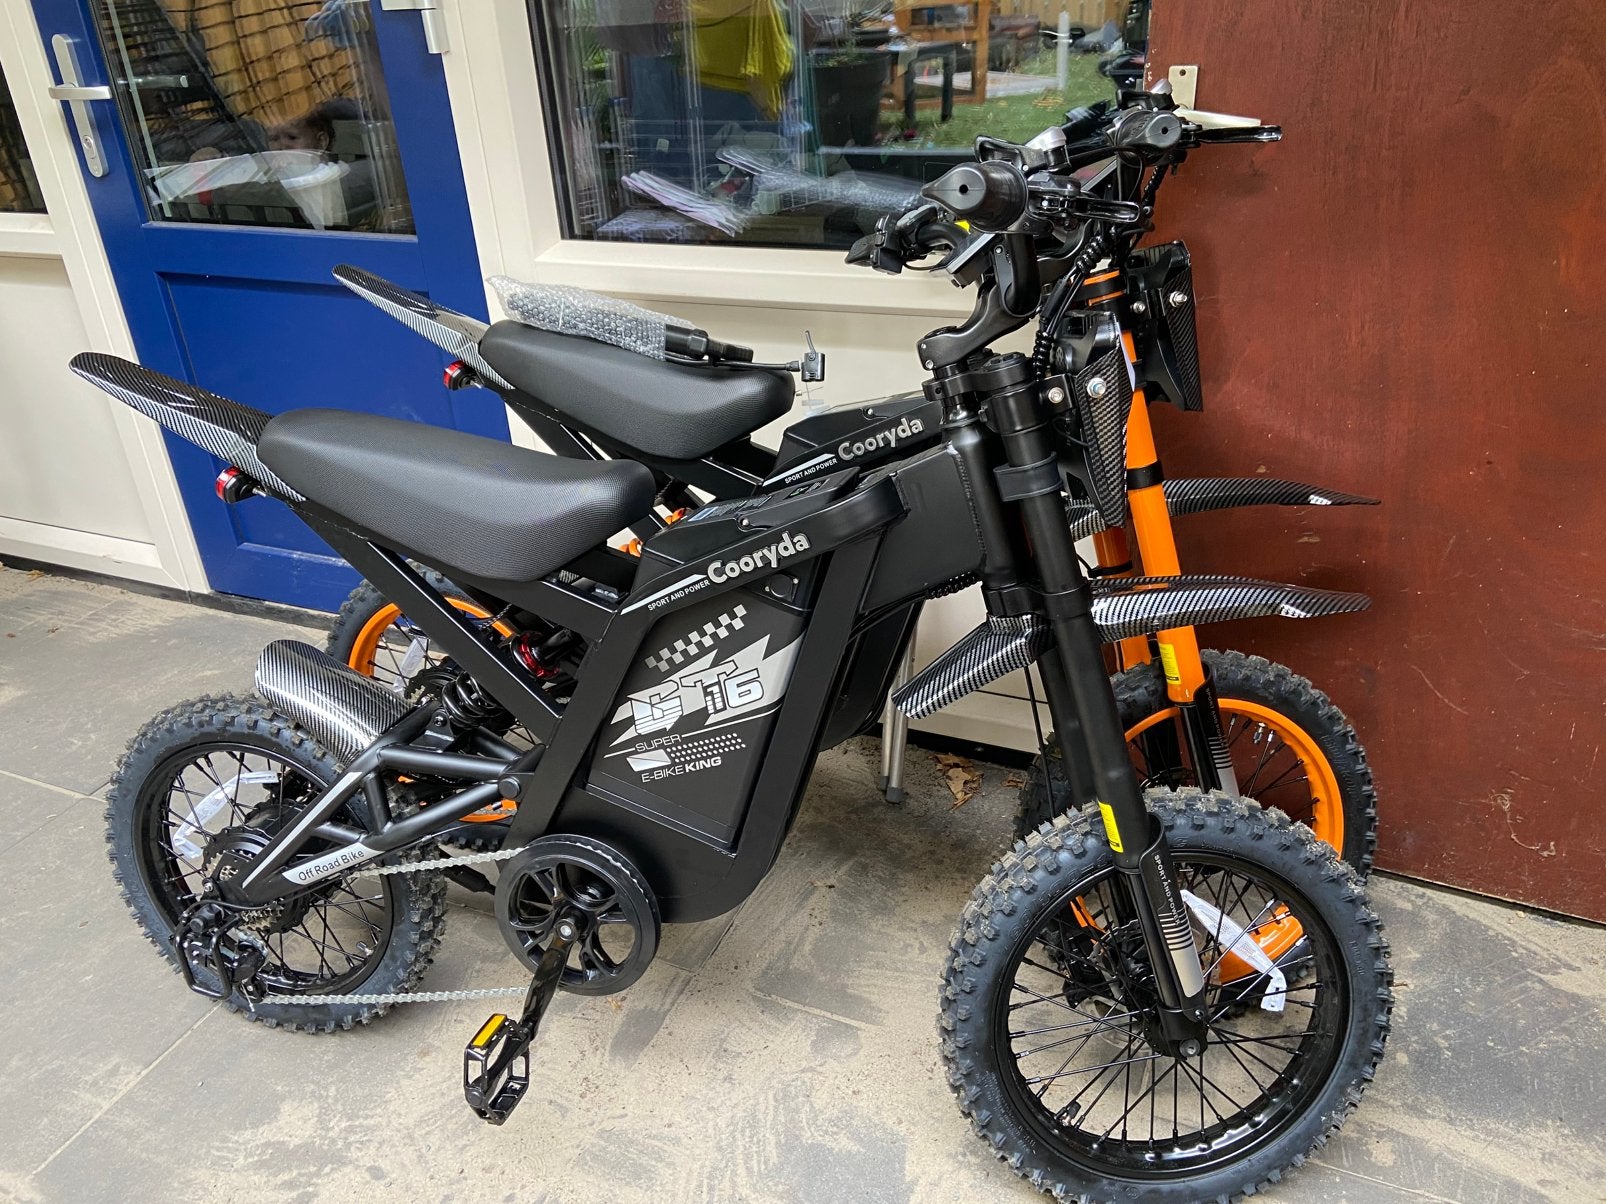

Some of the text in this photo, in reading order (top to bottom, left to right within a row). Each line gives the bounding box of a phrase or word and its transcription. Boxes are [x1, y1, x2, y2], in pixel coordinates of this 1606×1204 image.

[838, 417, 924, 461] Cooryda
[784, 458, 838, 484] SPORT AND POWER
[707, 531, 811, 584] Cooryda
[647, 580, 711, 611] SPORT AND POWER
[634, 733, 682, 752] SUPER
[641, 756, 722, 783] E-BIKE KING
[298, 851, 365, 881] Off Road Bike
[1154, 855, 1166, 880] SPORT
[1162, 881, 1171, 897] AND
